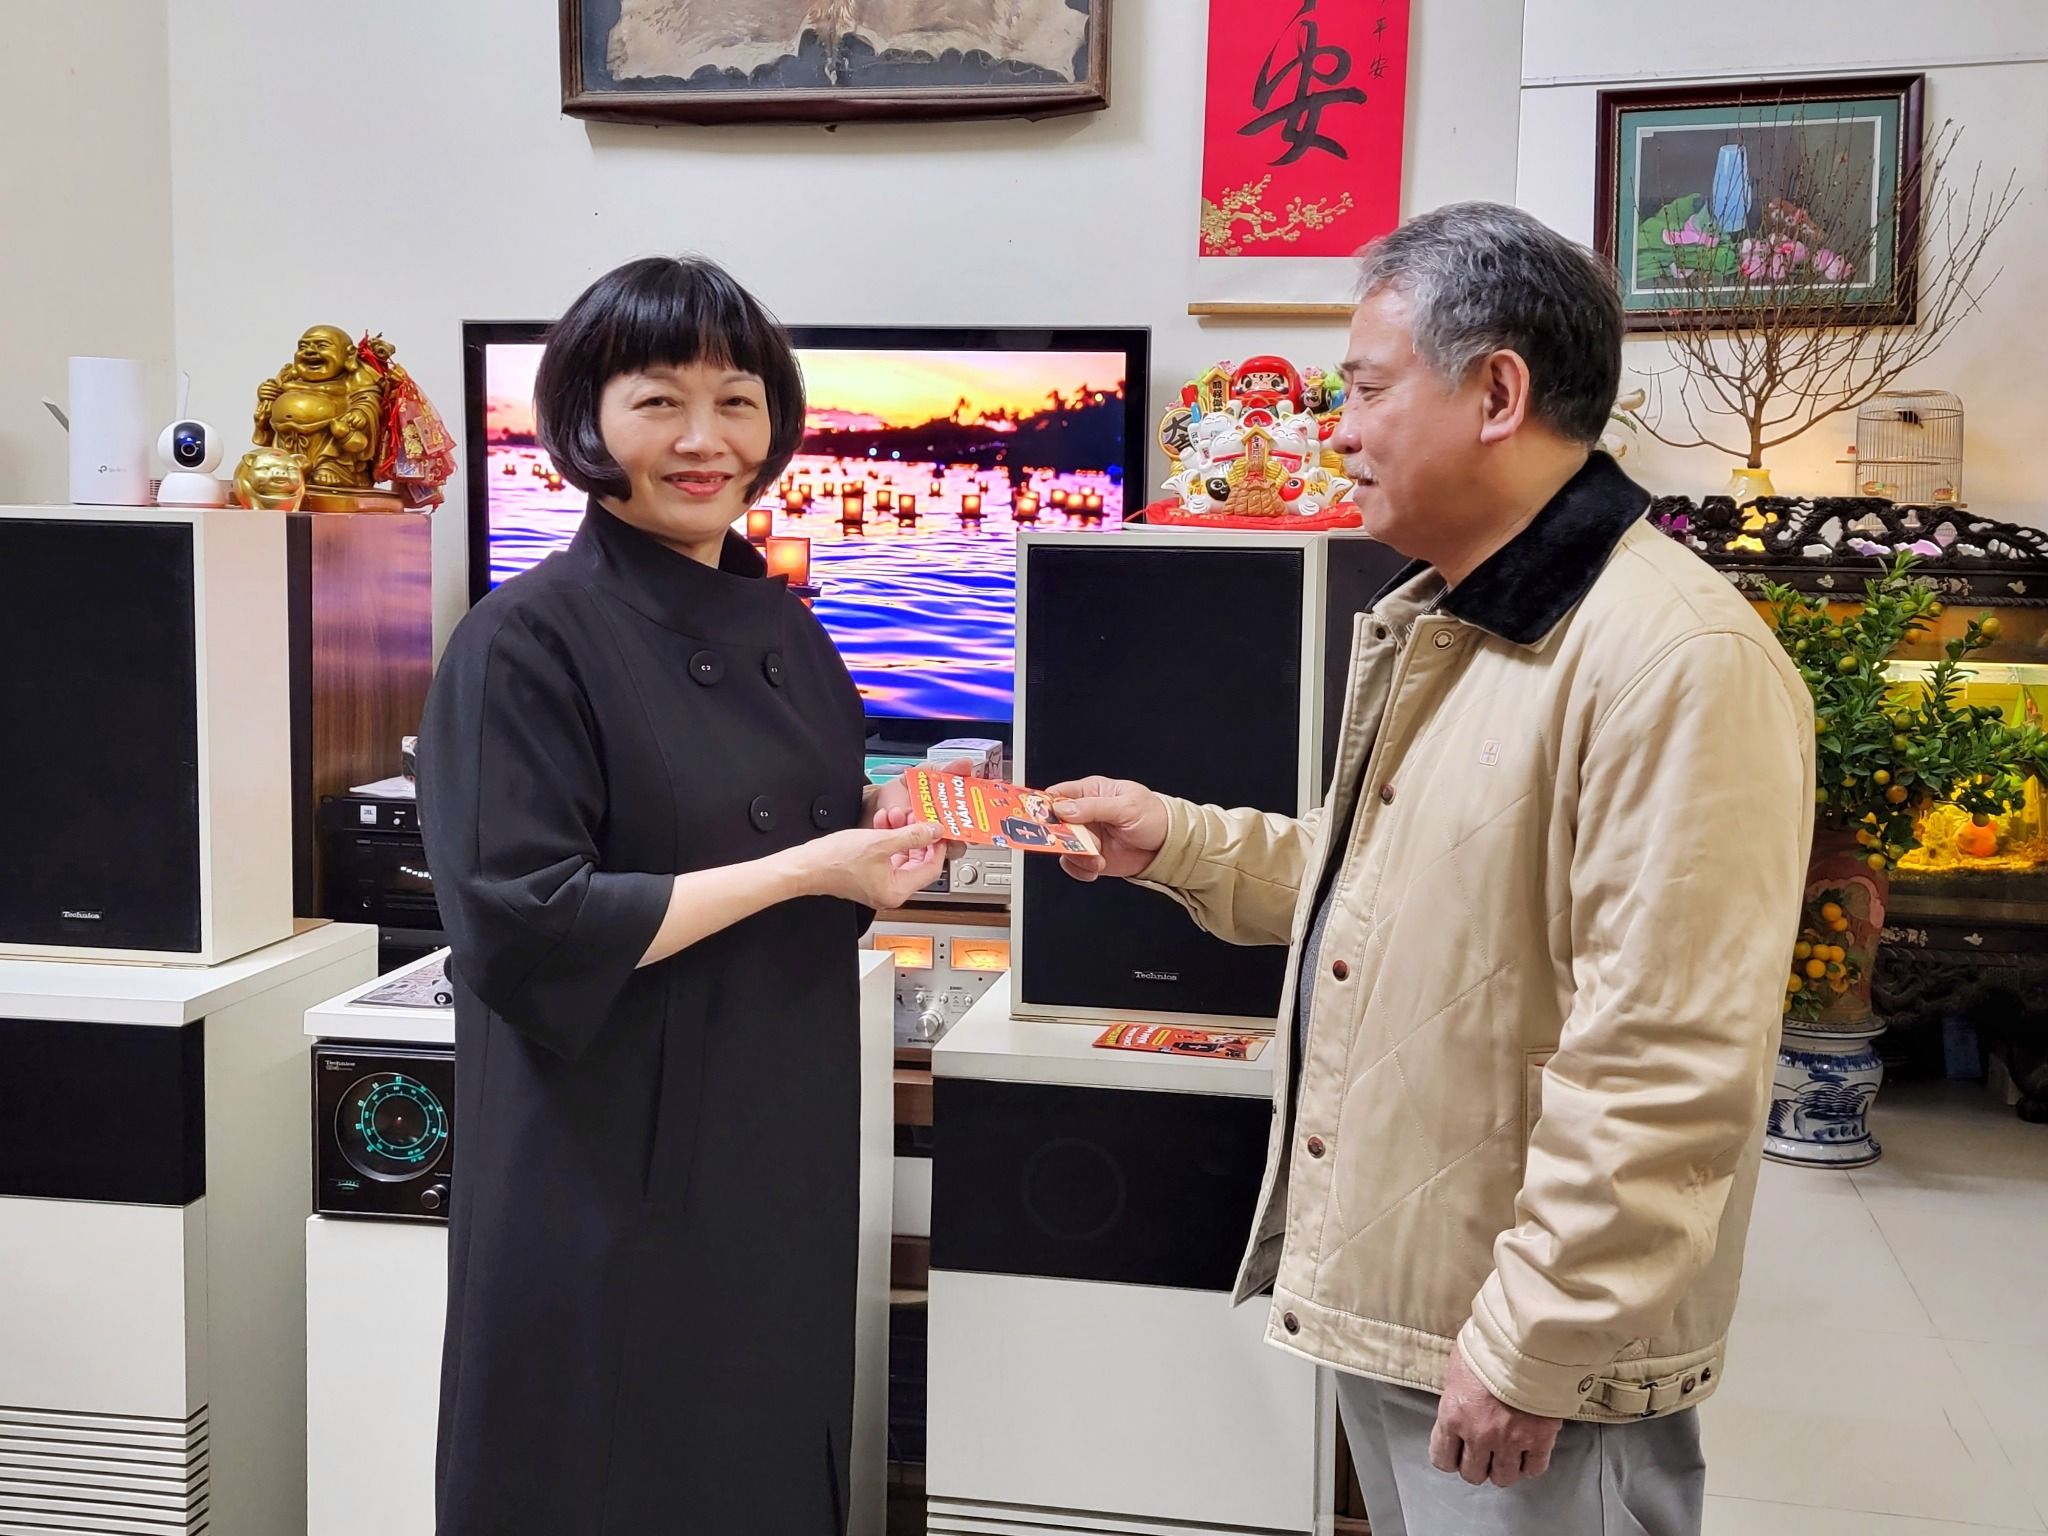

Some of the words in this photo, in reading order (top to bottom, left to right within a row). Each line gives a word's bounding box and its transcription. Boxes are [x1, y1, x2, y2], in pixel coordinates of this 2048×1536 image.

[917, 771, 939, 823] HEYSHOP
[954, 799, 974, 828] NĂM
[62, 911, 100, 920] Technics
[1134, 971, 1177, 981] Technics
